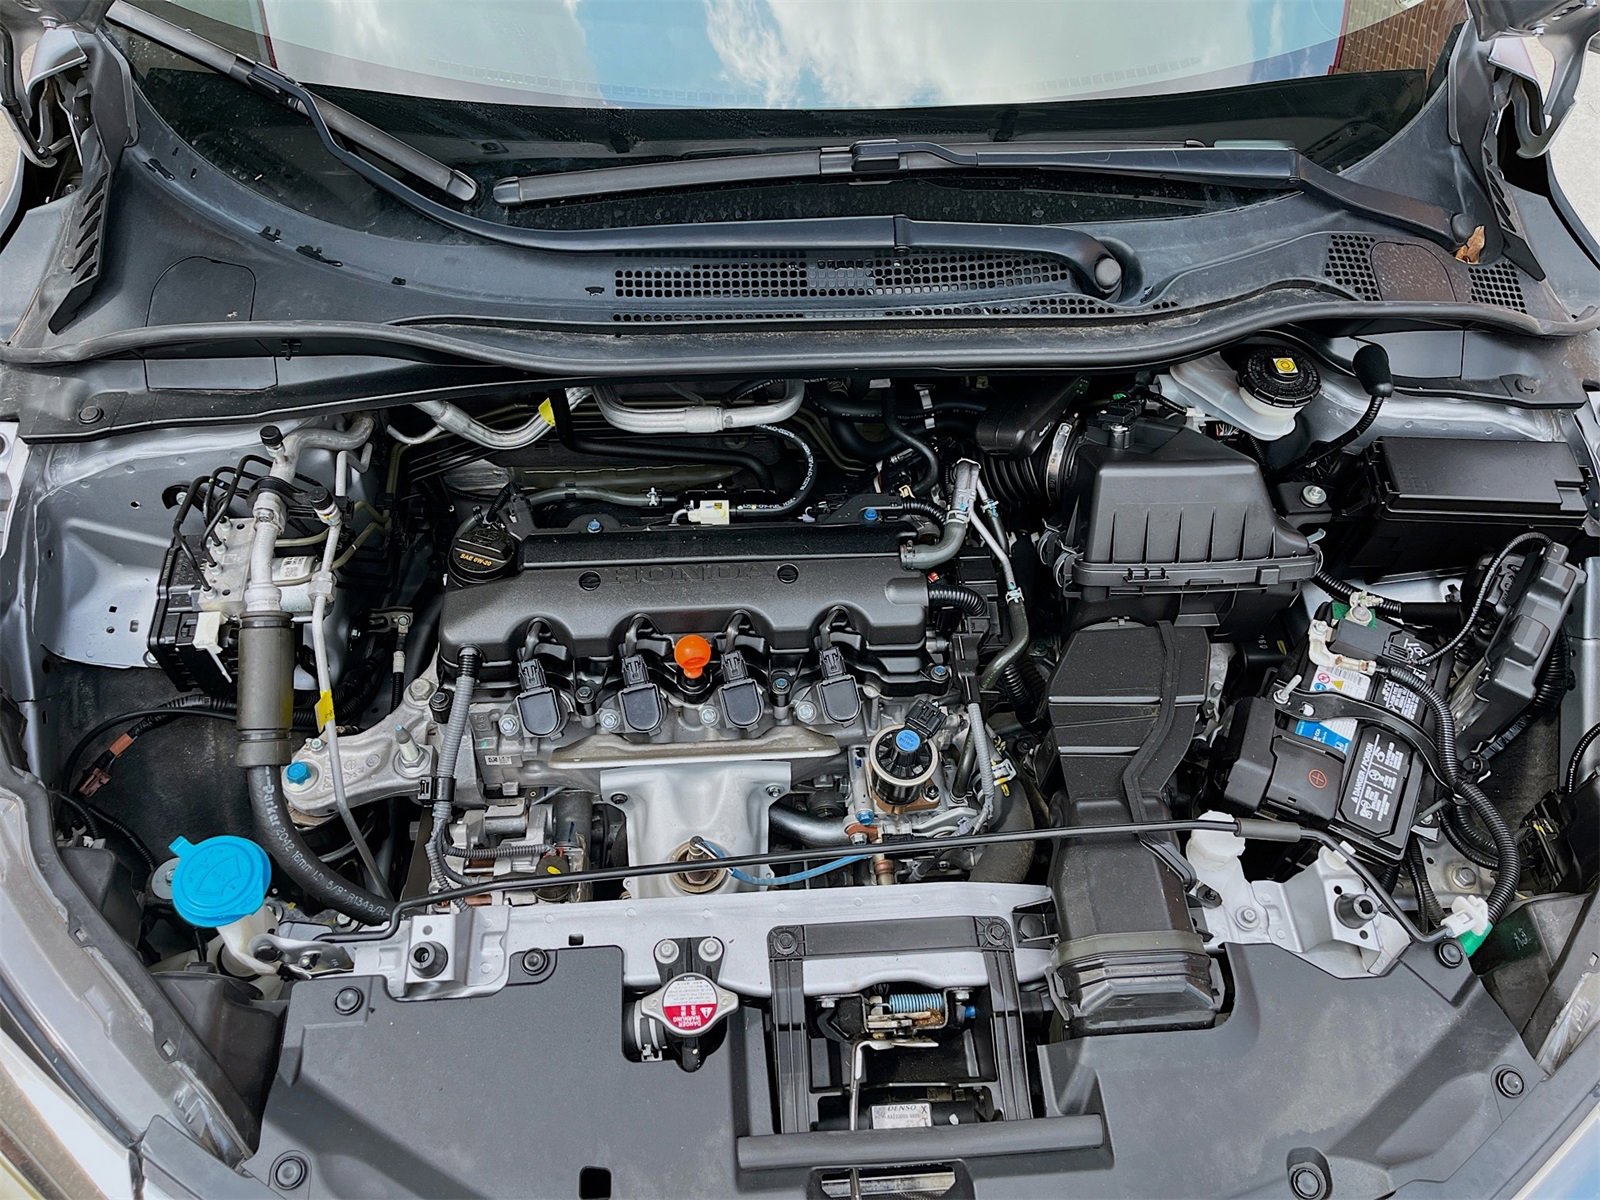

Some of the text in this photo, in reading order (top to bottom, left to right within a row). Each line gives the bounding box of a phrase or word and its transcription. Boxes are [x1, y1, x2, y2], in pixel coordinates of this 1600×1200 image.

[459, 553, 493, 567] SAE 0W-20
[615, 562, 775, 585] HONDA
[1352, 770, 1366, 798] DANGER
[1361, 742, 1374, 767] POISON
[263, 784, 281, 826] Parker
[276, 828, 295, 852] 2042
[291, 850, 313, 872] 16mm
[887, 1104, 917, 1112] DENSO
